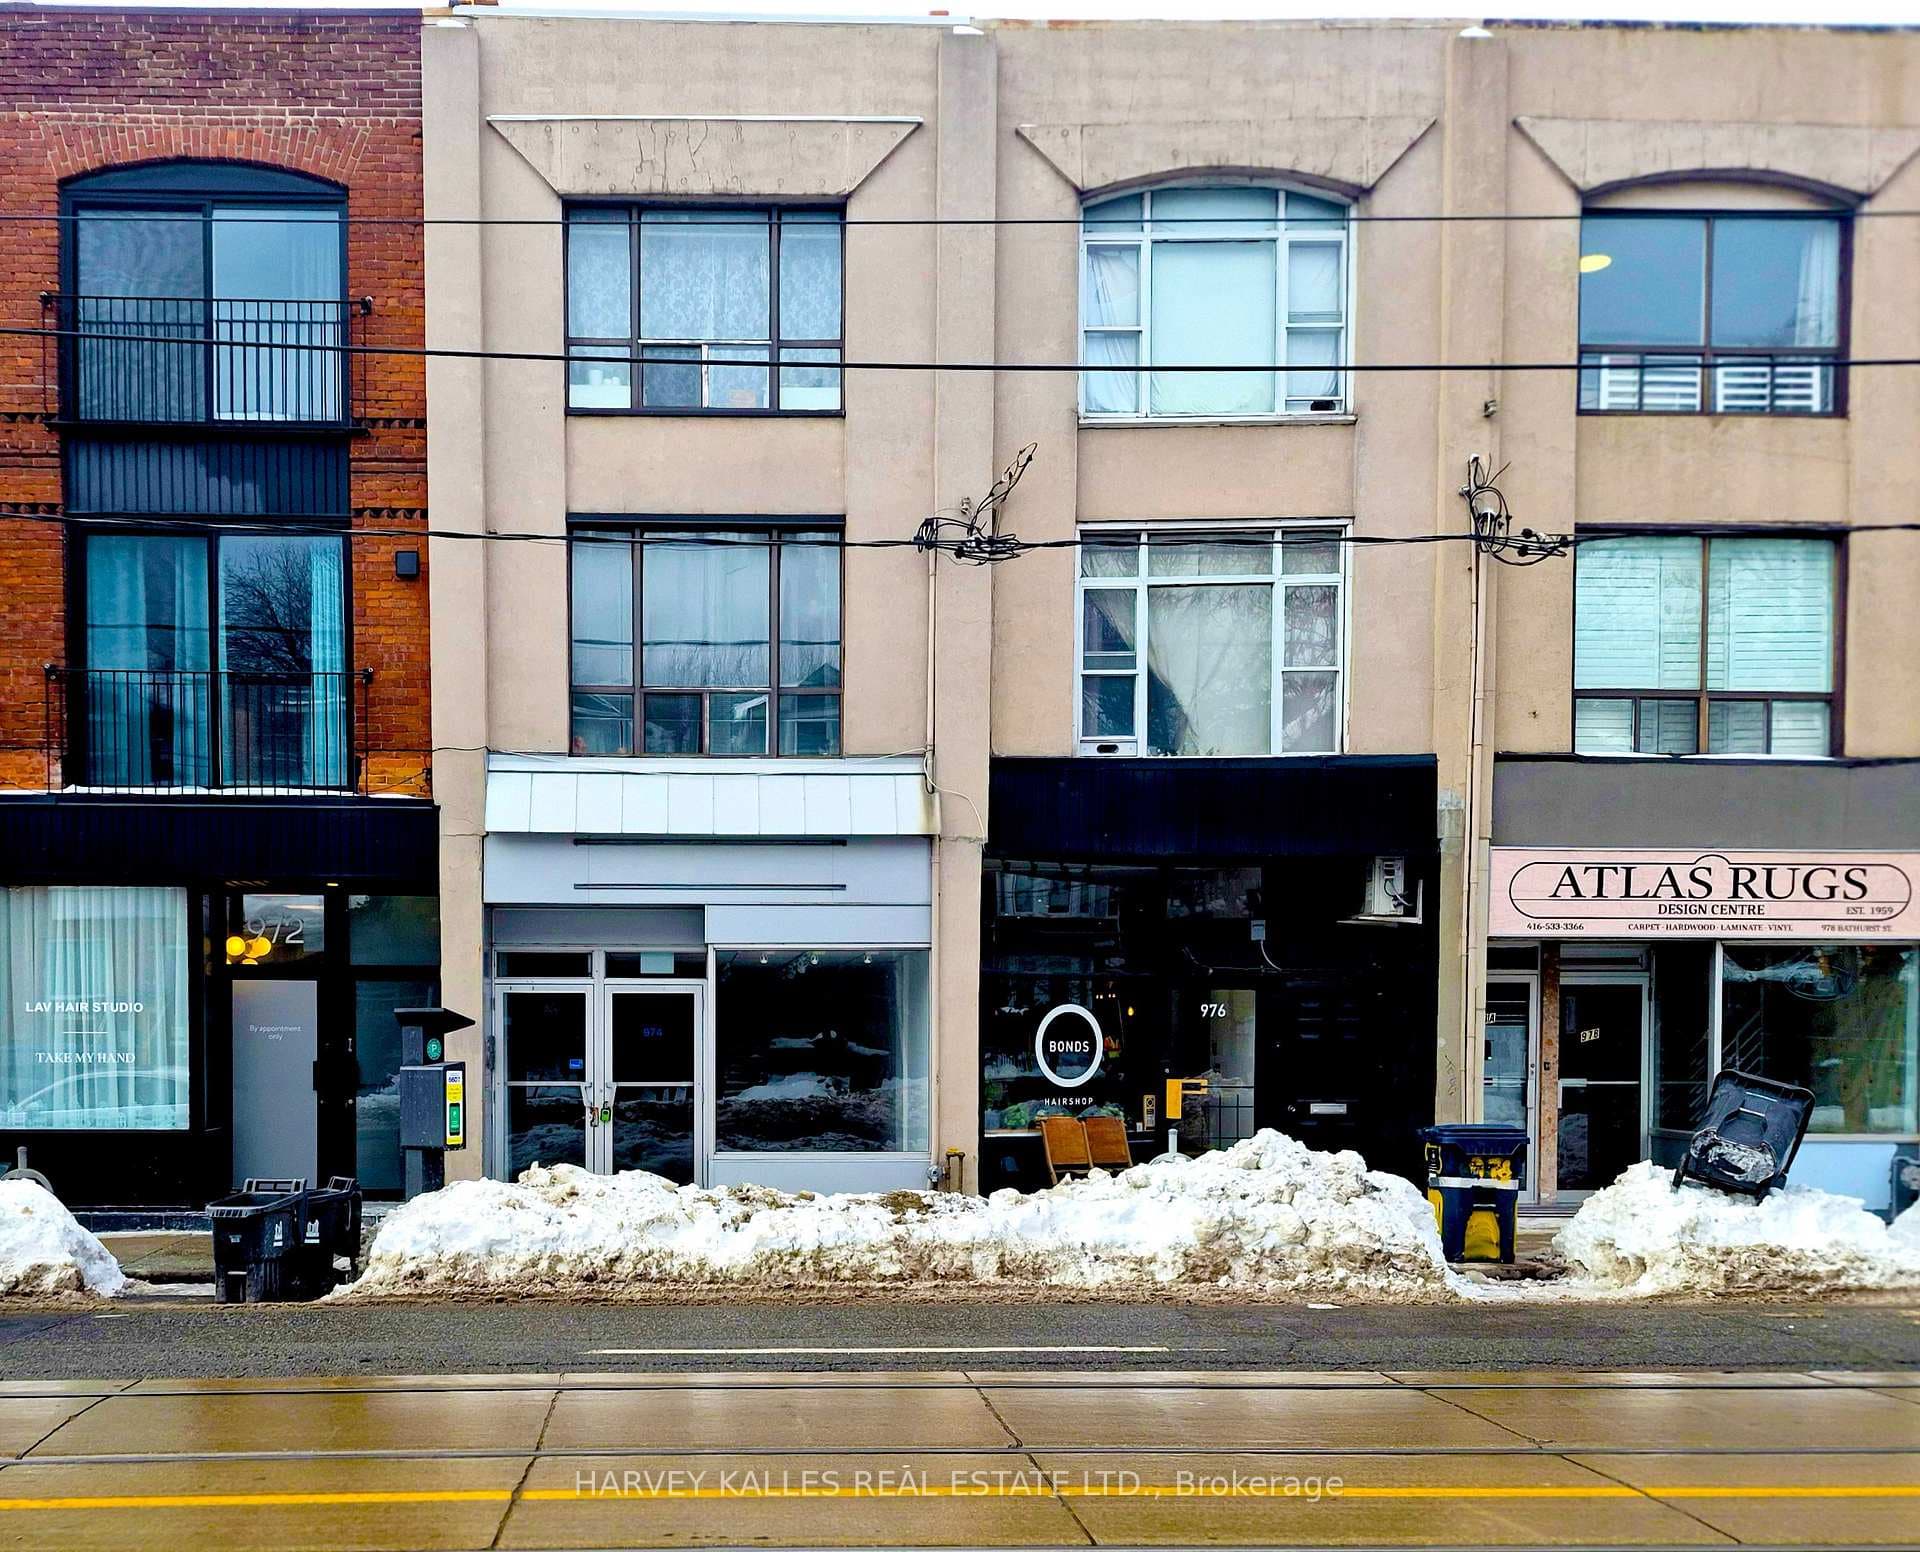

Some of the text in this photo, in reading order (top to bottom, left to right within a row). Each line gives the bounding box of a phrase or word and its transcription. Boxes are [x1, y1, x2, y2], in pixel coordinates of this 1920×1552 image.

[1548, 865, 1868, 900] ATLAS RUGS
[1658, 904, 1765, 915] DESIGN CENTRE
[1871, 906, 1894, 915] 1959
[1526, 922, 1584, 931] 416-533-3366
[1628, 923, 1793, 932] CARPET HARDWOOD LAMINATE VINYL
[25, 1002, 143, 1013] LAV HAIR STUDIO
[1200, 1003, 1226, 1018] 976
[1581, 1029, 1599, 1041] 978
[1049, 1040, 1090, 1053] BONDS
[35, 1052, 136, 1063] TAKE MY HAND
[1044, 1097, 1094, 1106] HAIRSHOP
